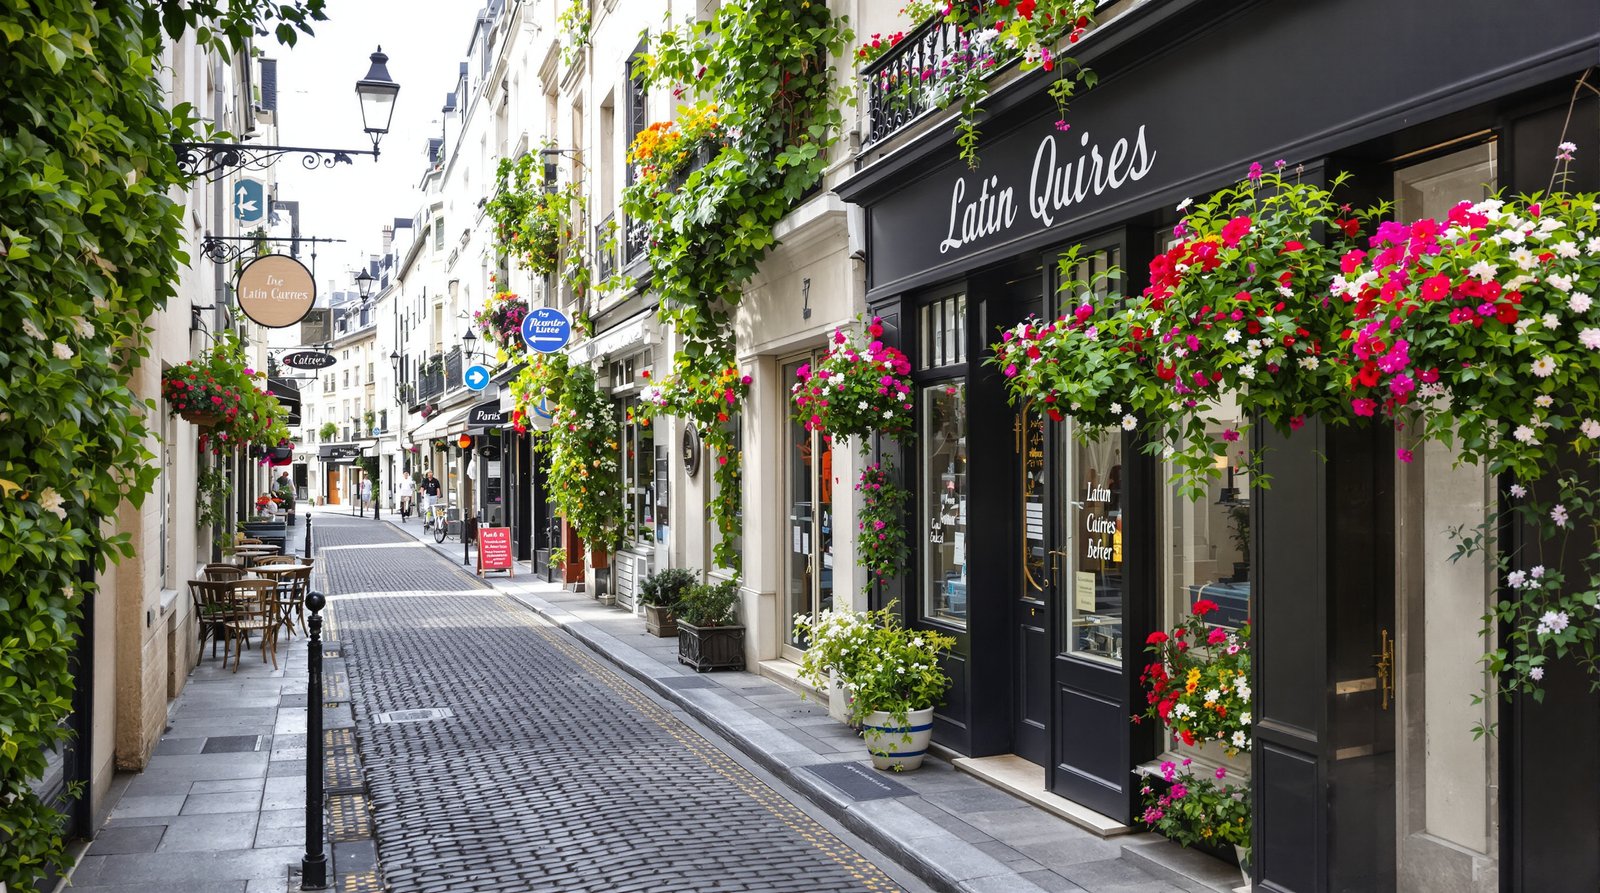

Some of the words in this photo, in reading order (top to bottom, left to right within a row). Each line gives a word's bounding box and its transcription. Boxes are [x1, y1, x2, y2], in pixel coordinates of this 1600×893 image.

[940, 175, 1018, 254] Latin
[1029, 124, 1157, 227] Quires
[243, 287, 267, 299] Latin
